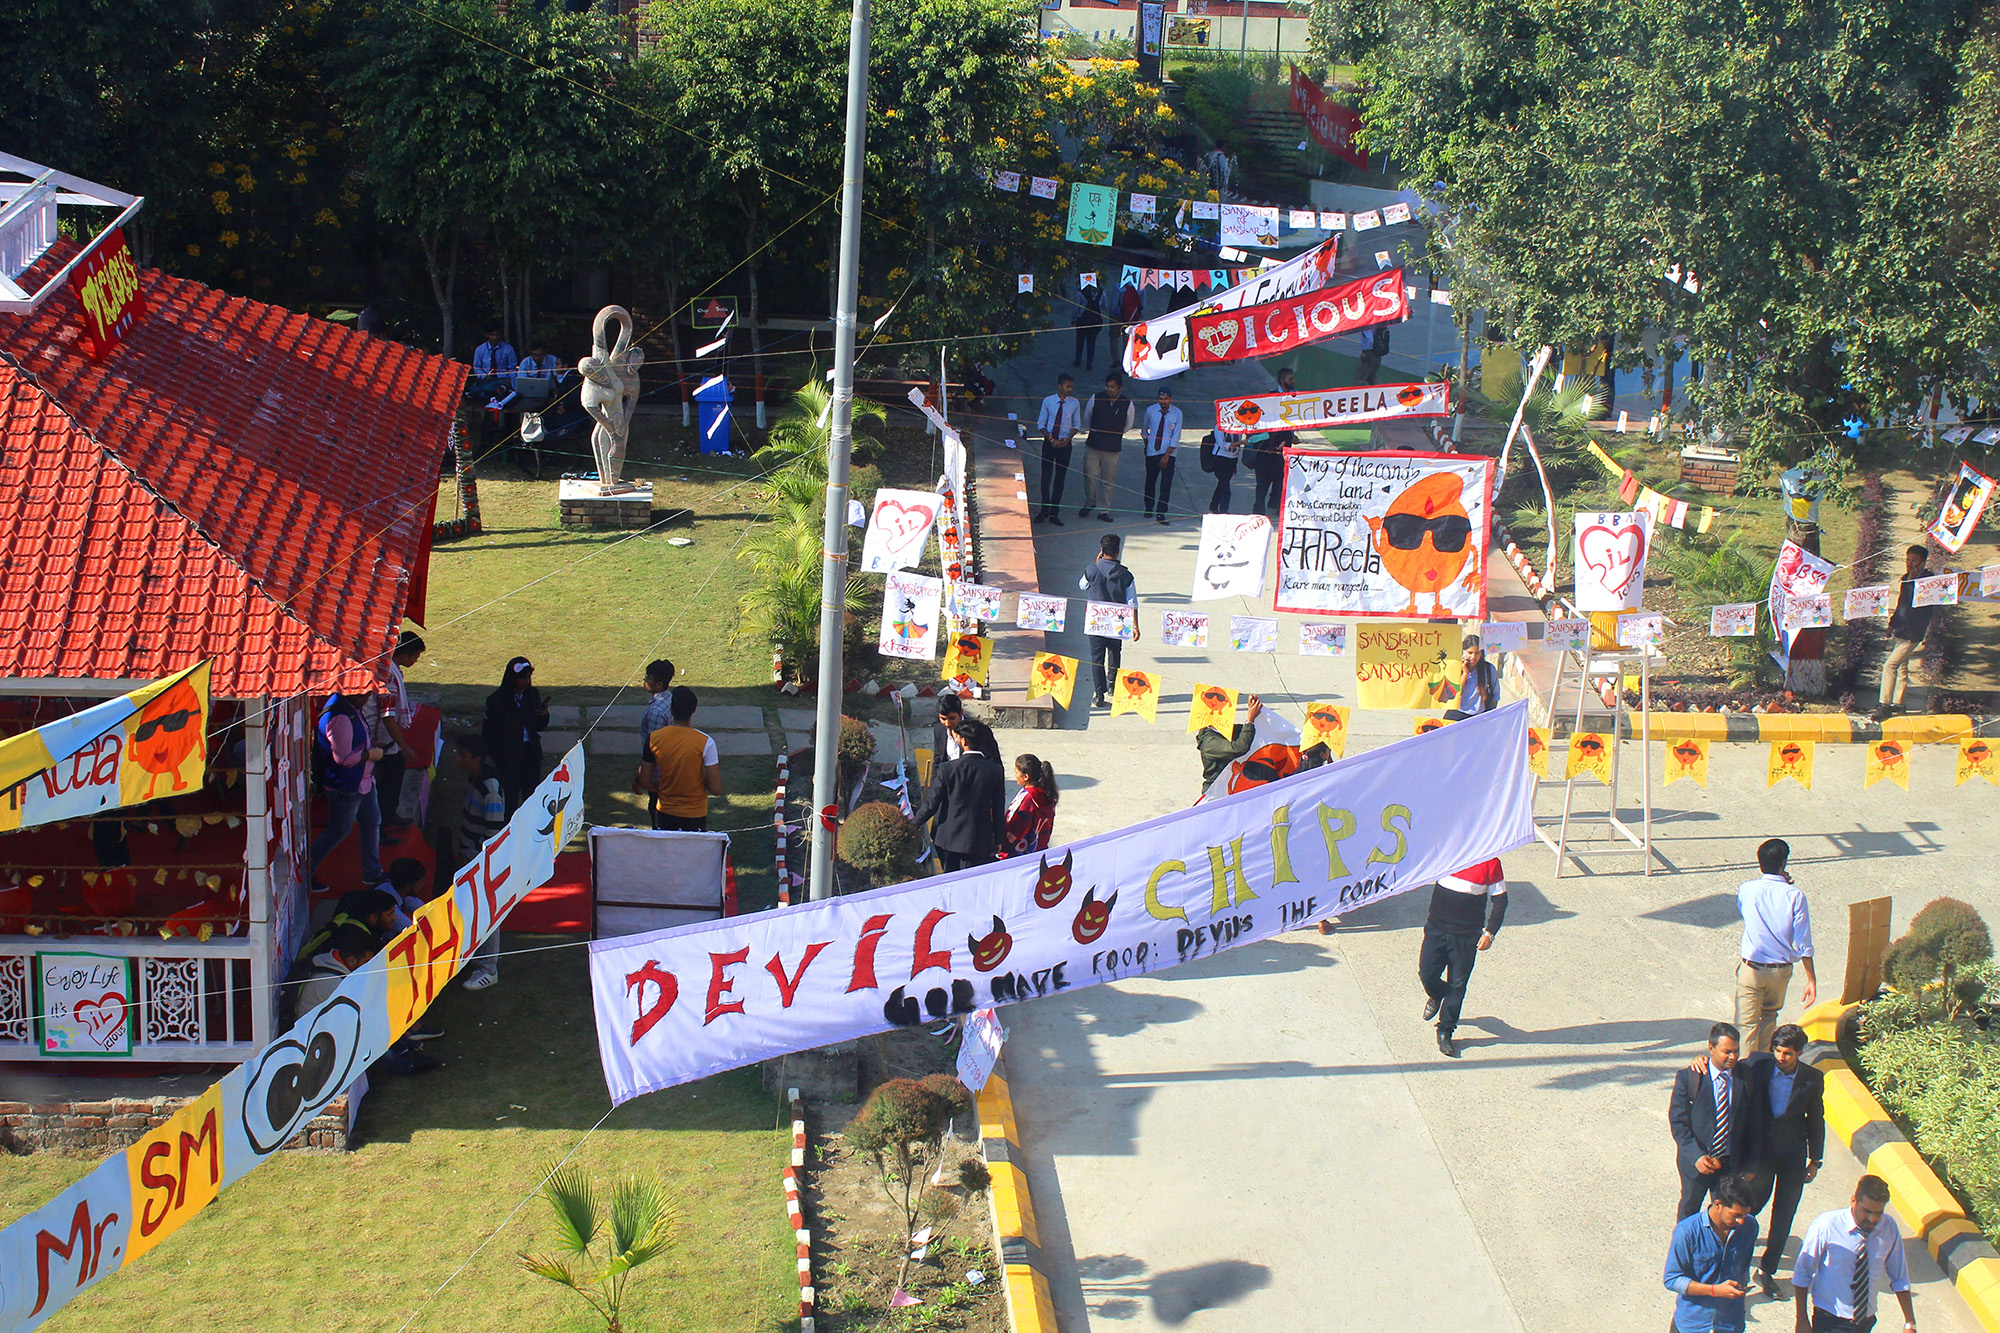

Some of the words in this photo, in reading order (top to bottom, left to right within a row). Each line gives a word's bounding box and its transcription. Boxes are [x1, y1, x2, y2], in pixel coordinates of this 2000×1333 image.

[1243, 278, 1400, 349] ICIOUS
[1339, 481, 1374, 499] land
[1356, 661, 1431, 683] SANSKAR
[1396, 648, 1410, 661] एक
[990, 960, 1072, 1002] MADE
[1277, 895, 1318, 928] THE
[28, 1199, 121, 1319] Mr.
[140, 1106, 219, 1238] SM
